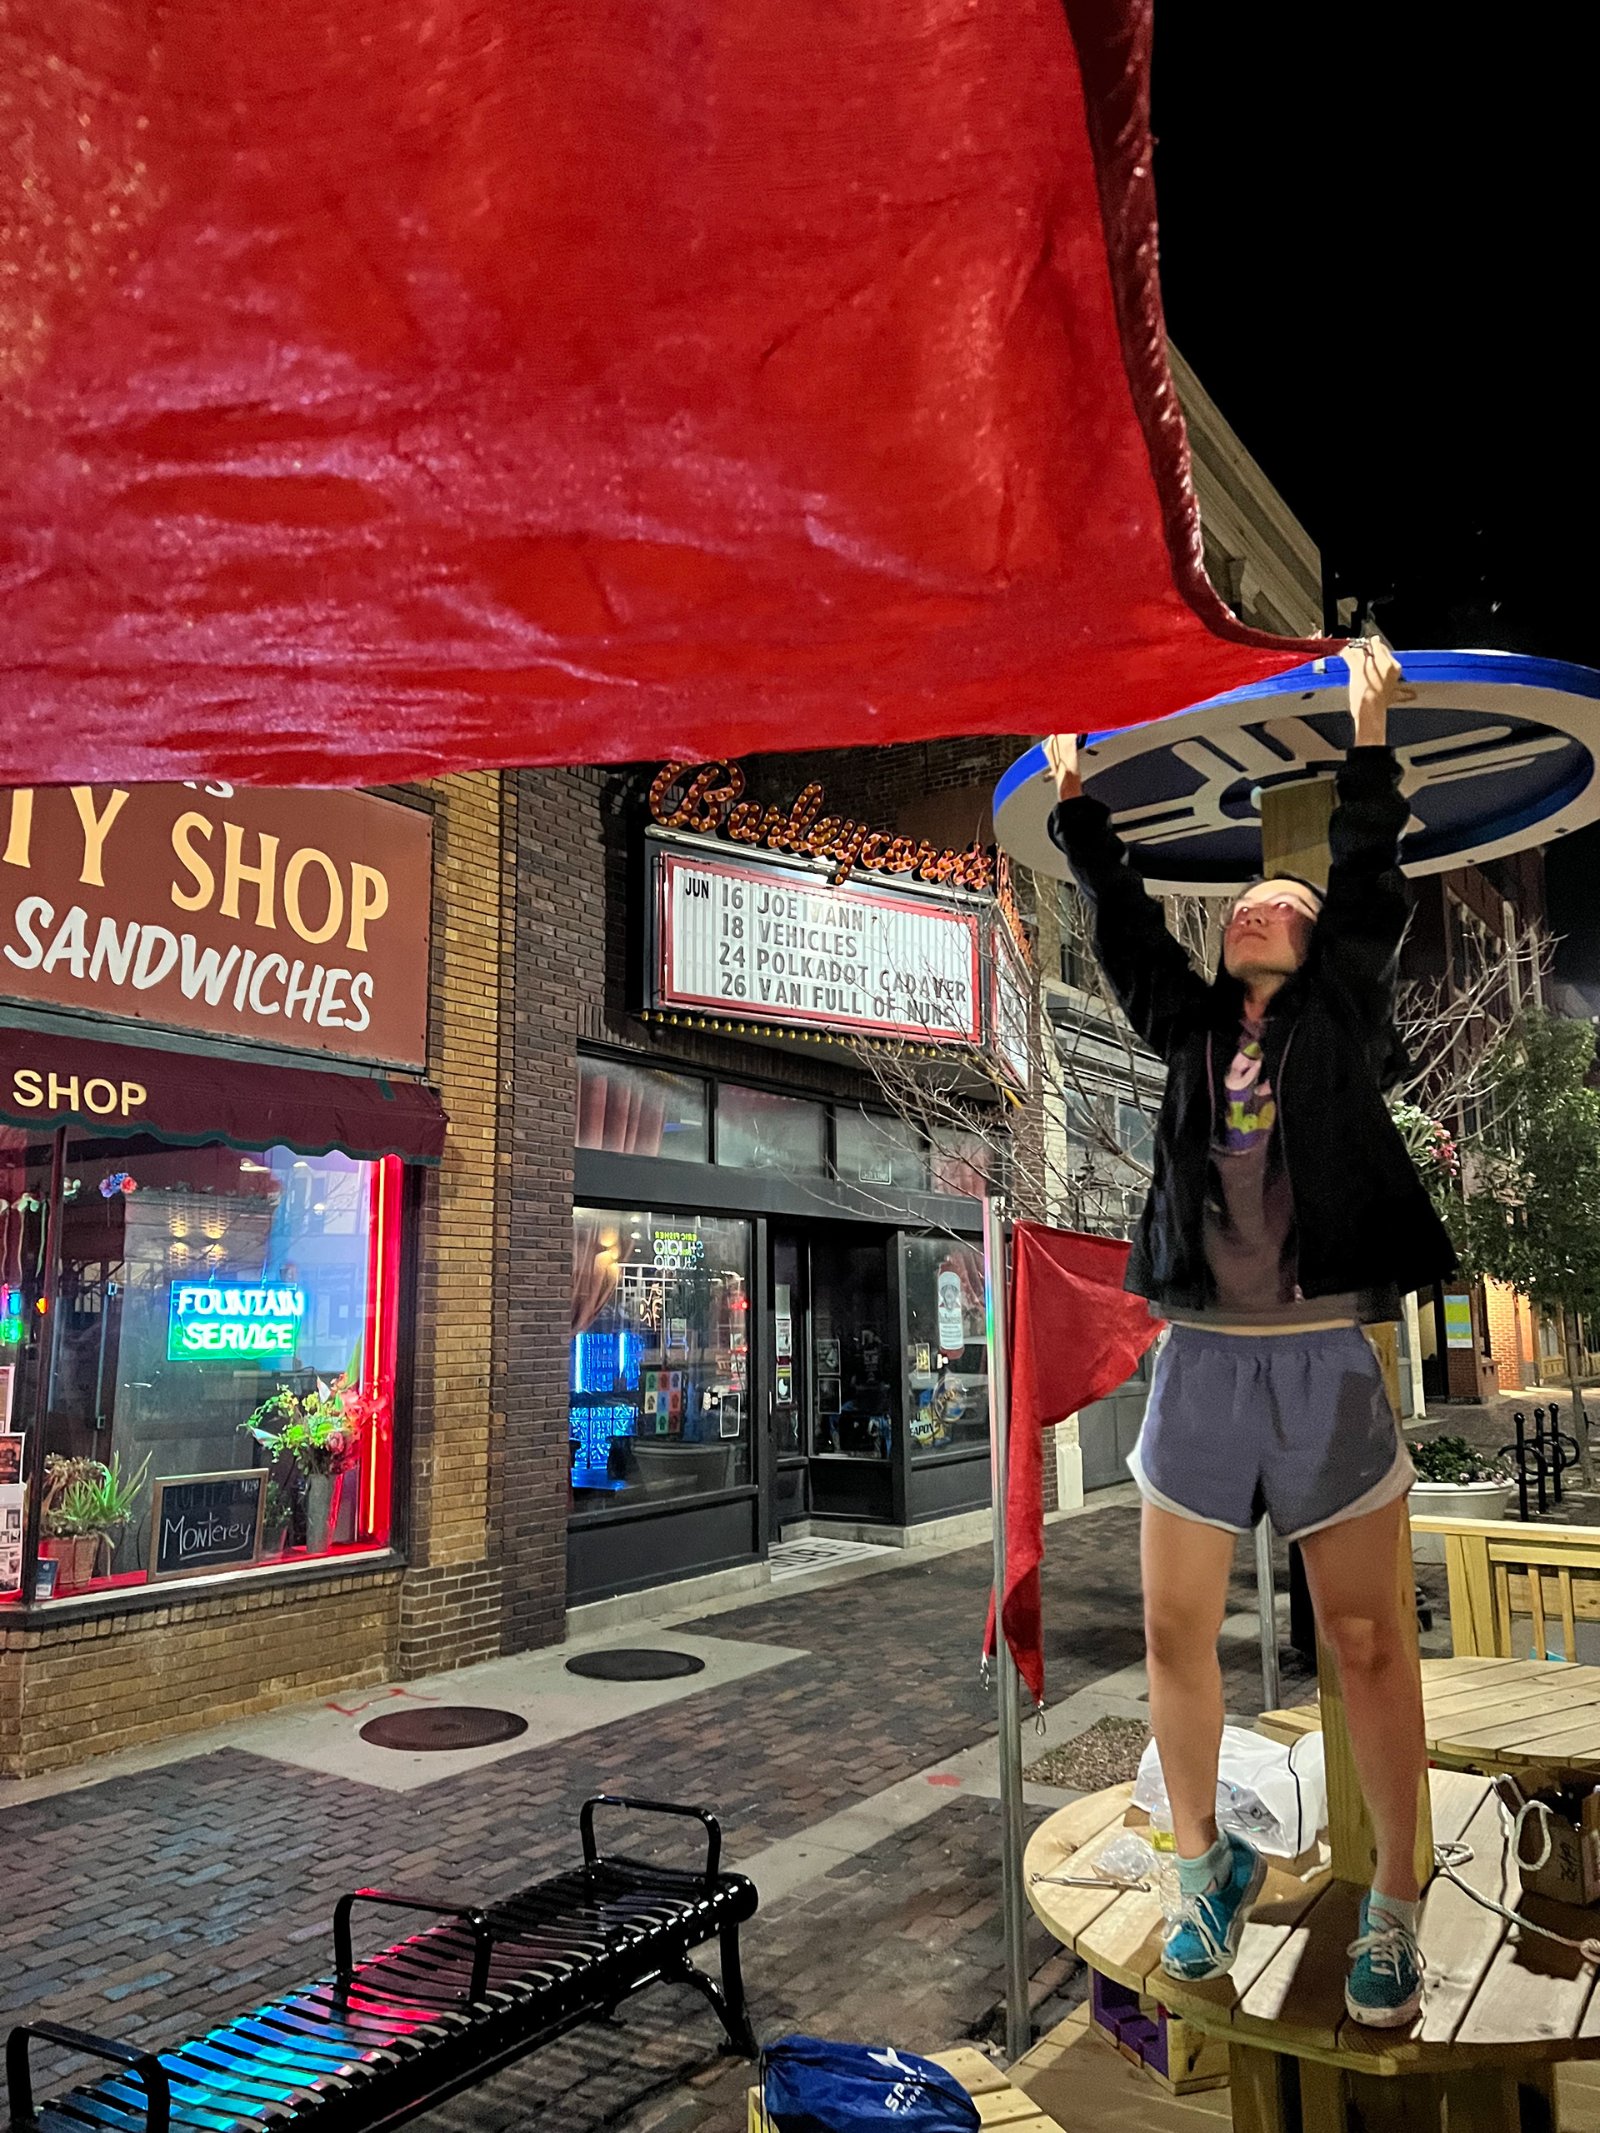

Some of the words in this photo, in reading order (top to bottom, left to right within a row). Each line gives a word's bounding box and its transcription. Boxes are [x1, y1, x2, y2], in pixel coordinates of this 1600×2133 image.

[172, 811, 389, 952] SHOP
[685, 877, 709, 899] JUN
[722, 883, 744, 909] 16
[757, 892, 798, 920] JOE
[722, 913, 744, 939] 18
[758, 920, 857, 958] VEHICLES
[3, 896, 374, 1032] SANDWICHES
[719, 942, 746, 969] 24
[756, 948, 869, 987] POLKADOT
[879, 969, 966, 1002] CADAVER
[721, 972, 747, 998] 26
[758, 977, 801, 1006] VAN
[813, 986, 863, 1015] FULL
[874, 996, 896, 1019] OF
[907, 1000, 955, 1027] NUNS
[12, 1069, 148, 1116] SHOP
[177, 1288, 305, 1317] FOUNTAIN
[182, 1321, 294, 1350] SERVICE
[162, 1511, 252, 1561] Monterey
